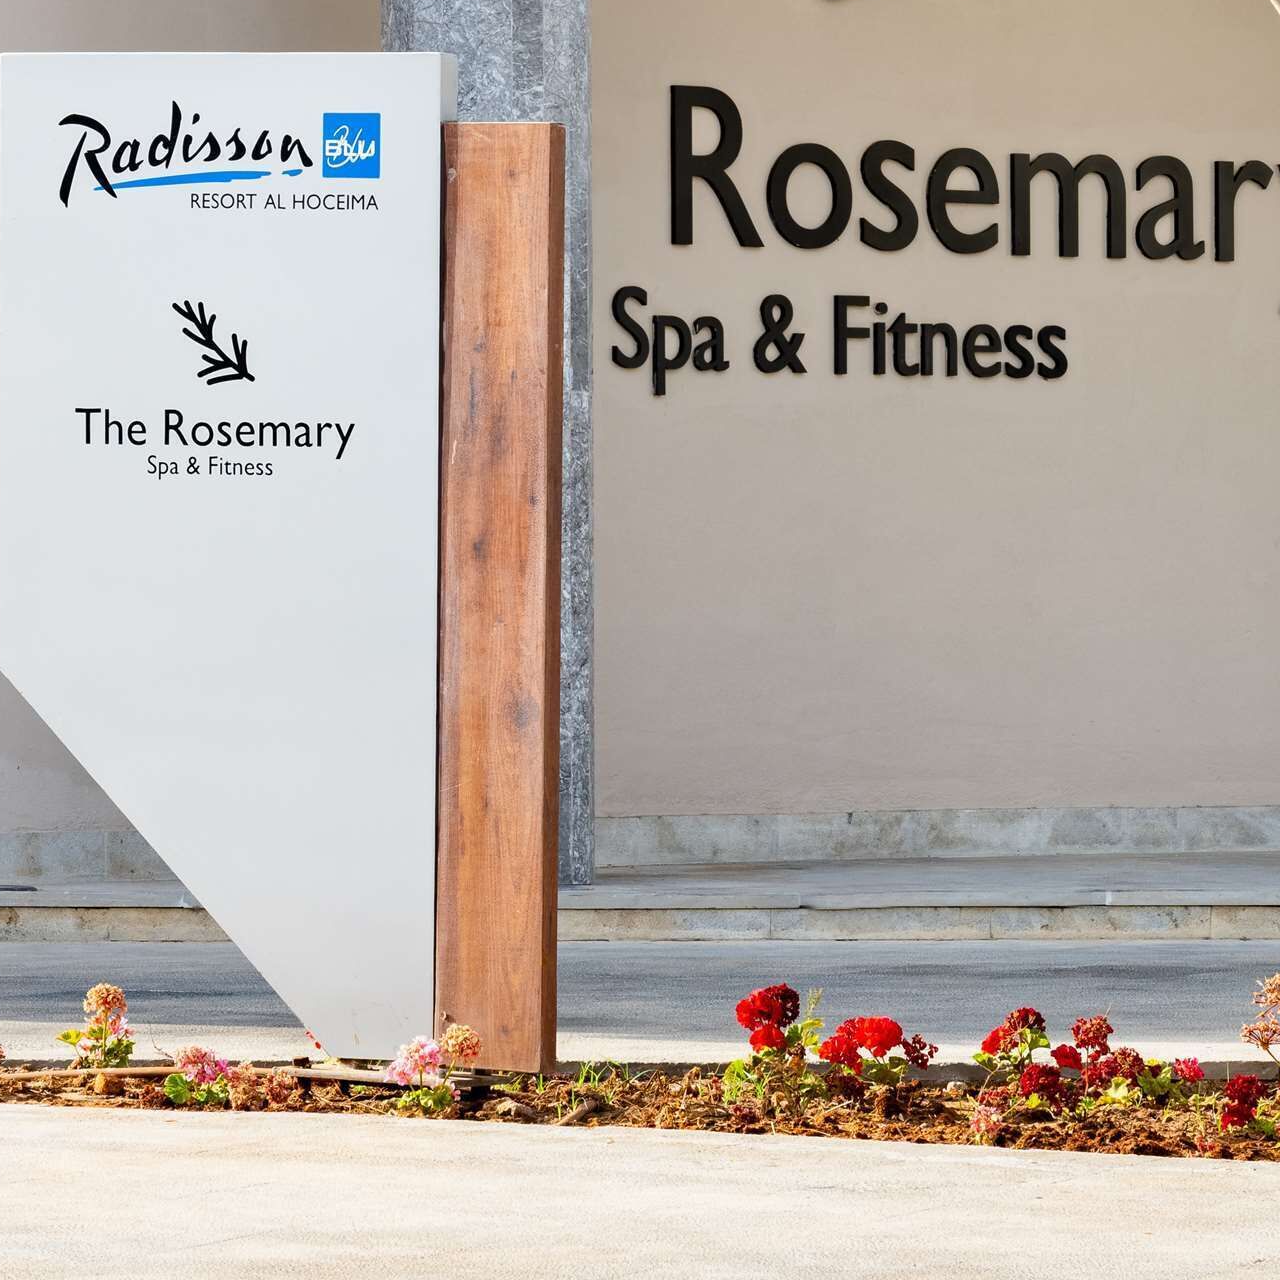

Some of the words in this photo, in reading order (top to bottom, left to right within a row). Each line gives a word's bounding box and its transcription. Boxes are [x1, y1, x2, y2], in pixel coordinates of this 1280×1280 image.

[58, 100, 314, 207] Radisson
[190, 193, 257, 209] RESORT
[264, 194, 286, 210] AL
[293, 194, 379, 211] HOCEIMA
[611, 286, 730, 397] Spa
[753, 294, 808, 374] &
[833, 294, 1069, 381] Fitness
[75, 408, 147, 446] The
[164, 409, 356, 460] Rosemary
[147, 455, 179, 480] Spa
[187, 456, 201, 475] &
[208, 456, 273, 476] Fitness
